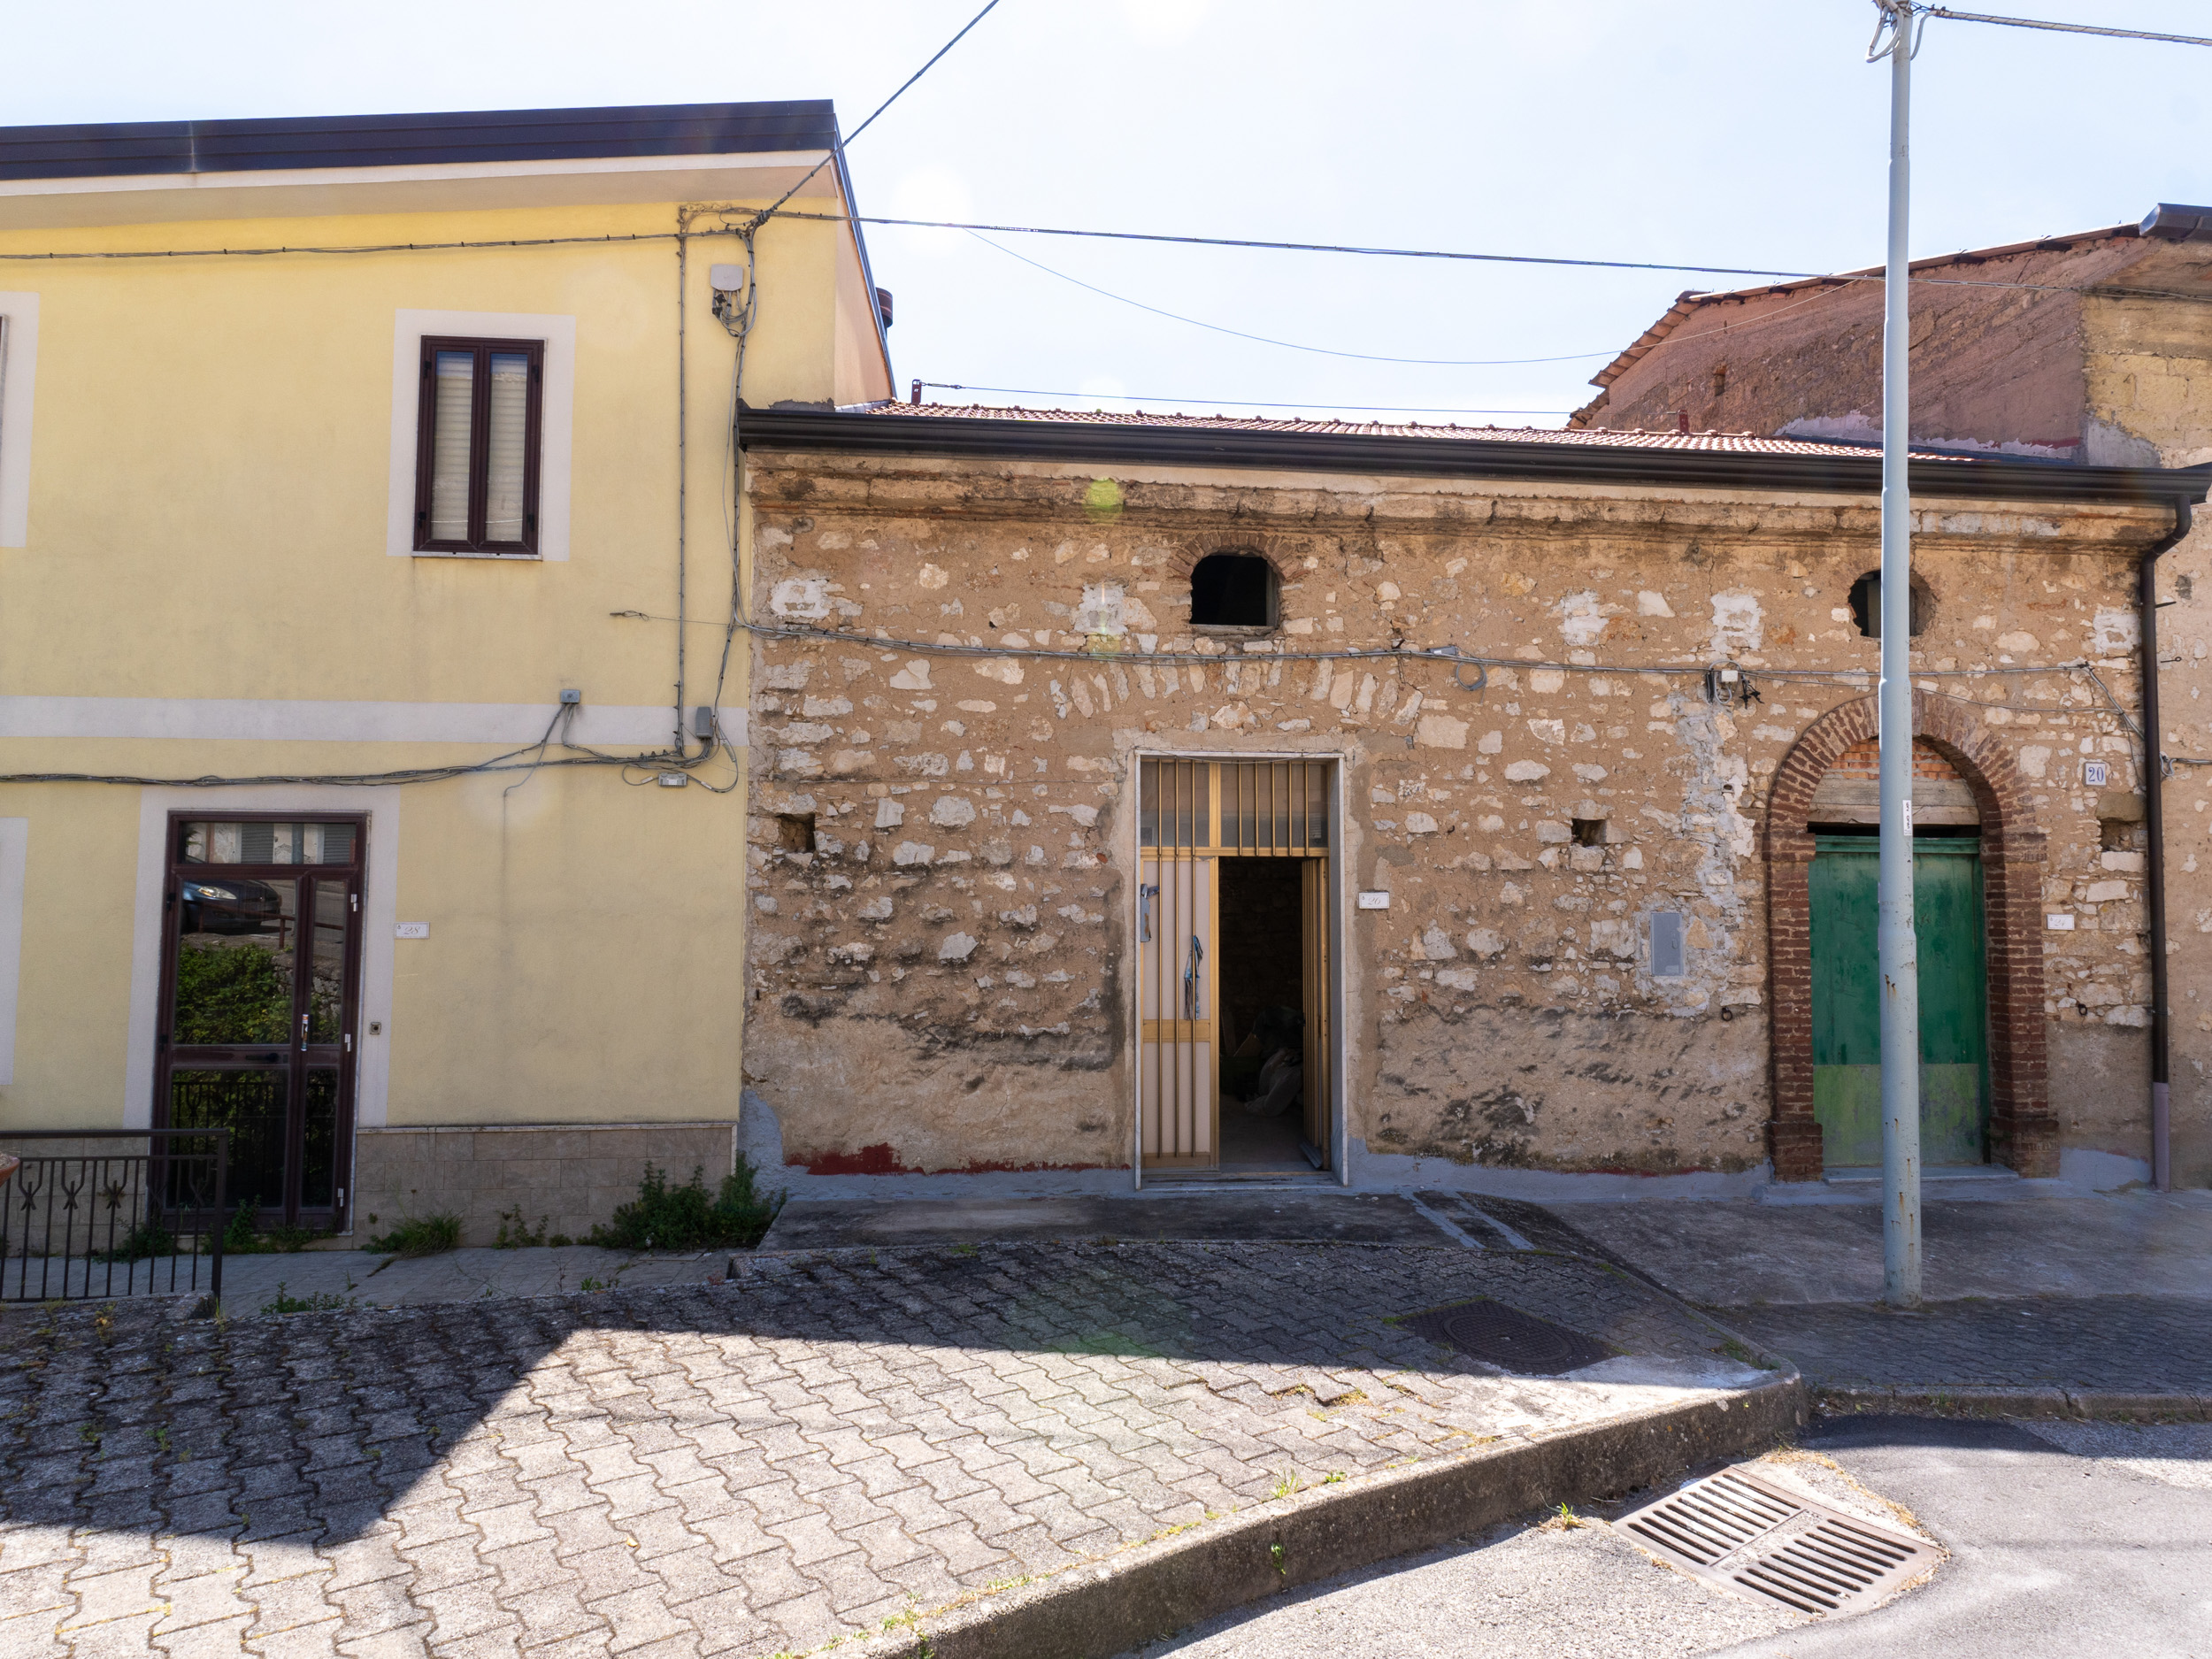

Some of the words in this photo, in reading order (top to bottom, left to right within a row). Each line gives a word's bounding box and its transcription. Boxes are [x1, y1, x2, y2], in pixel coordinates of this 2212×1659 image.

[2088, 766, 2104, 782] 20
[1368, 896, 1381, 905] 26
[403, 926, 421, 935] 28
